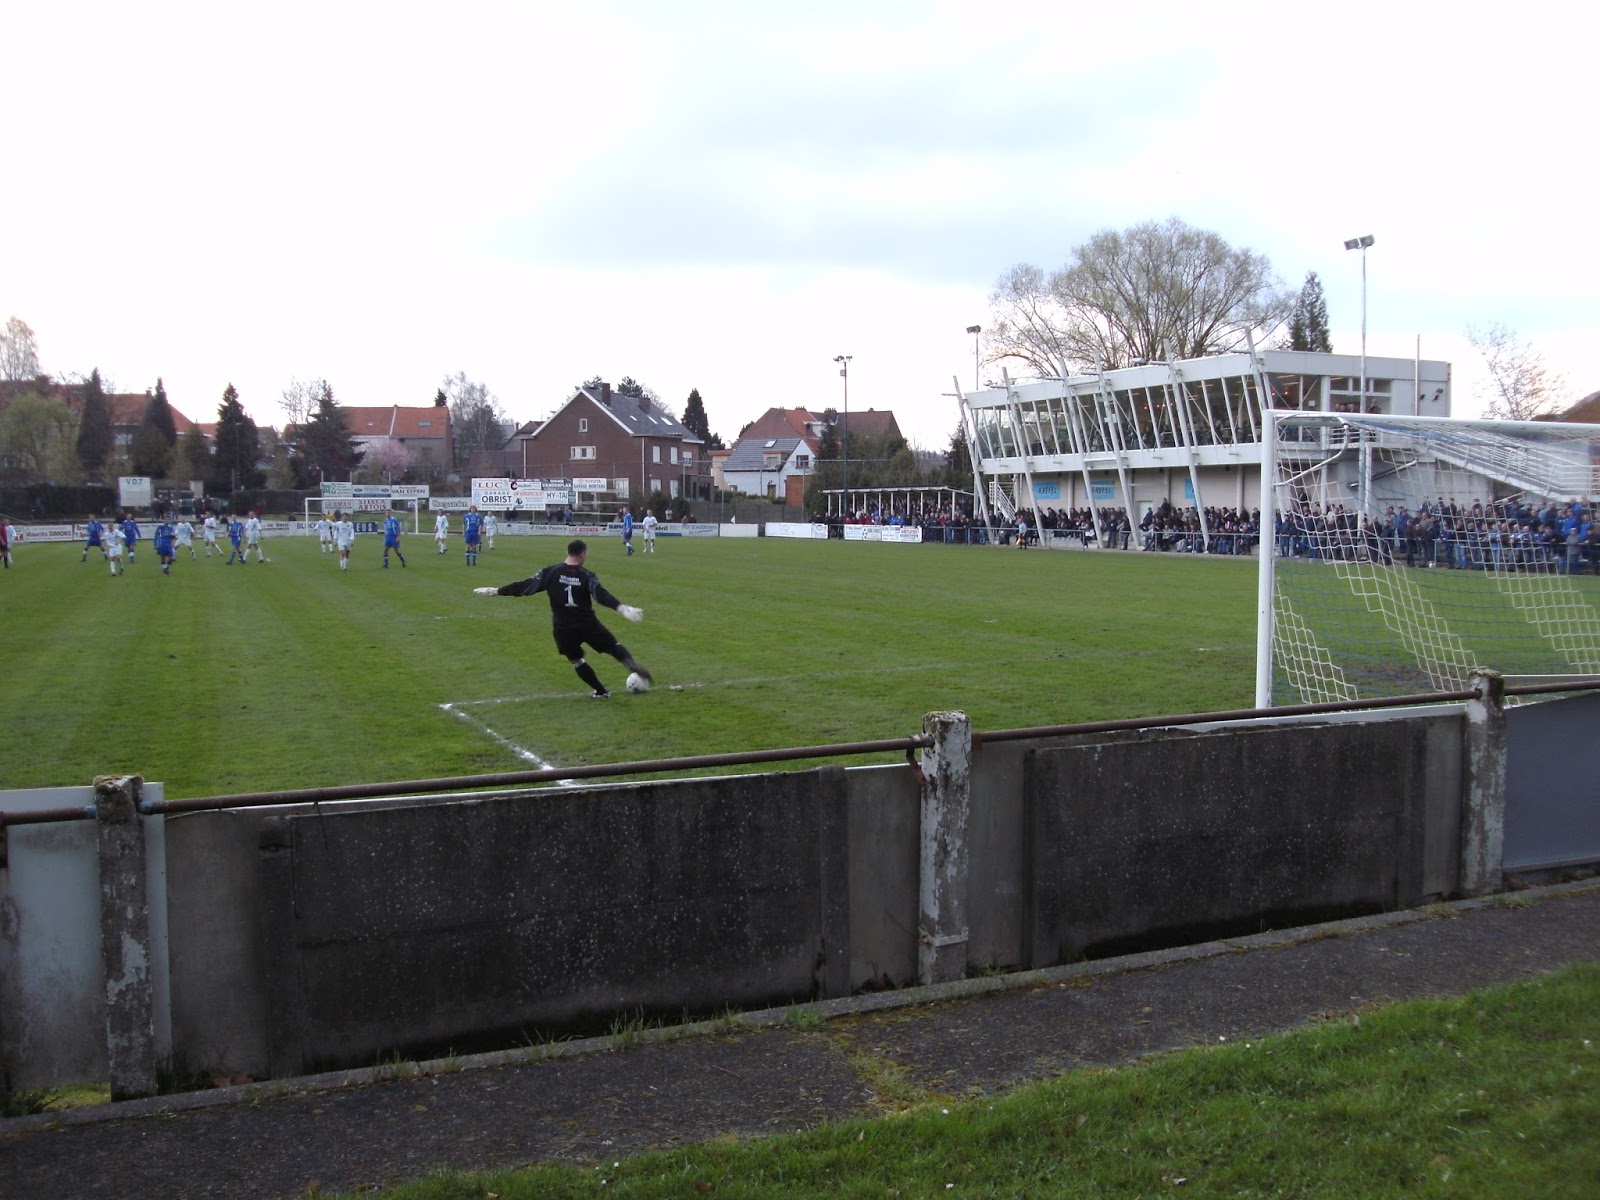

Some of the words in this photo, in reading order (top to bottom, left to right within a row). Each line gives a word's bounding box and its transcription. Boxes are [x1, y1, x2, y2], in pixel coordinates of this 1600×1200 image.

[478, 481, 502, 489] LUC
[481, 495, 513, 503] OBRIST
[564, 585, 579, 607] 1
